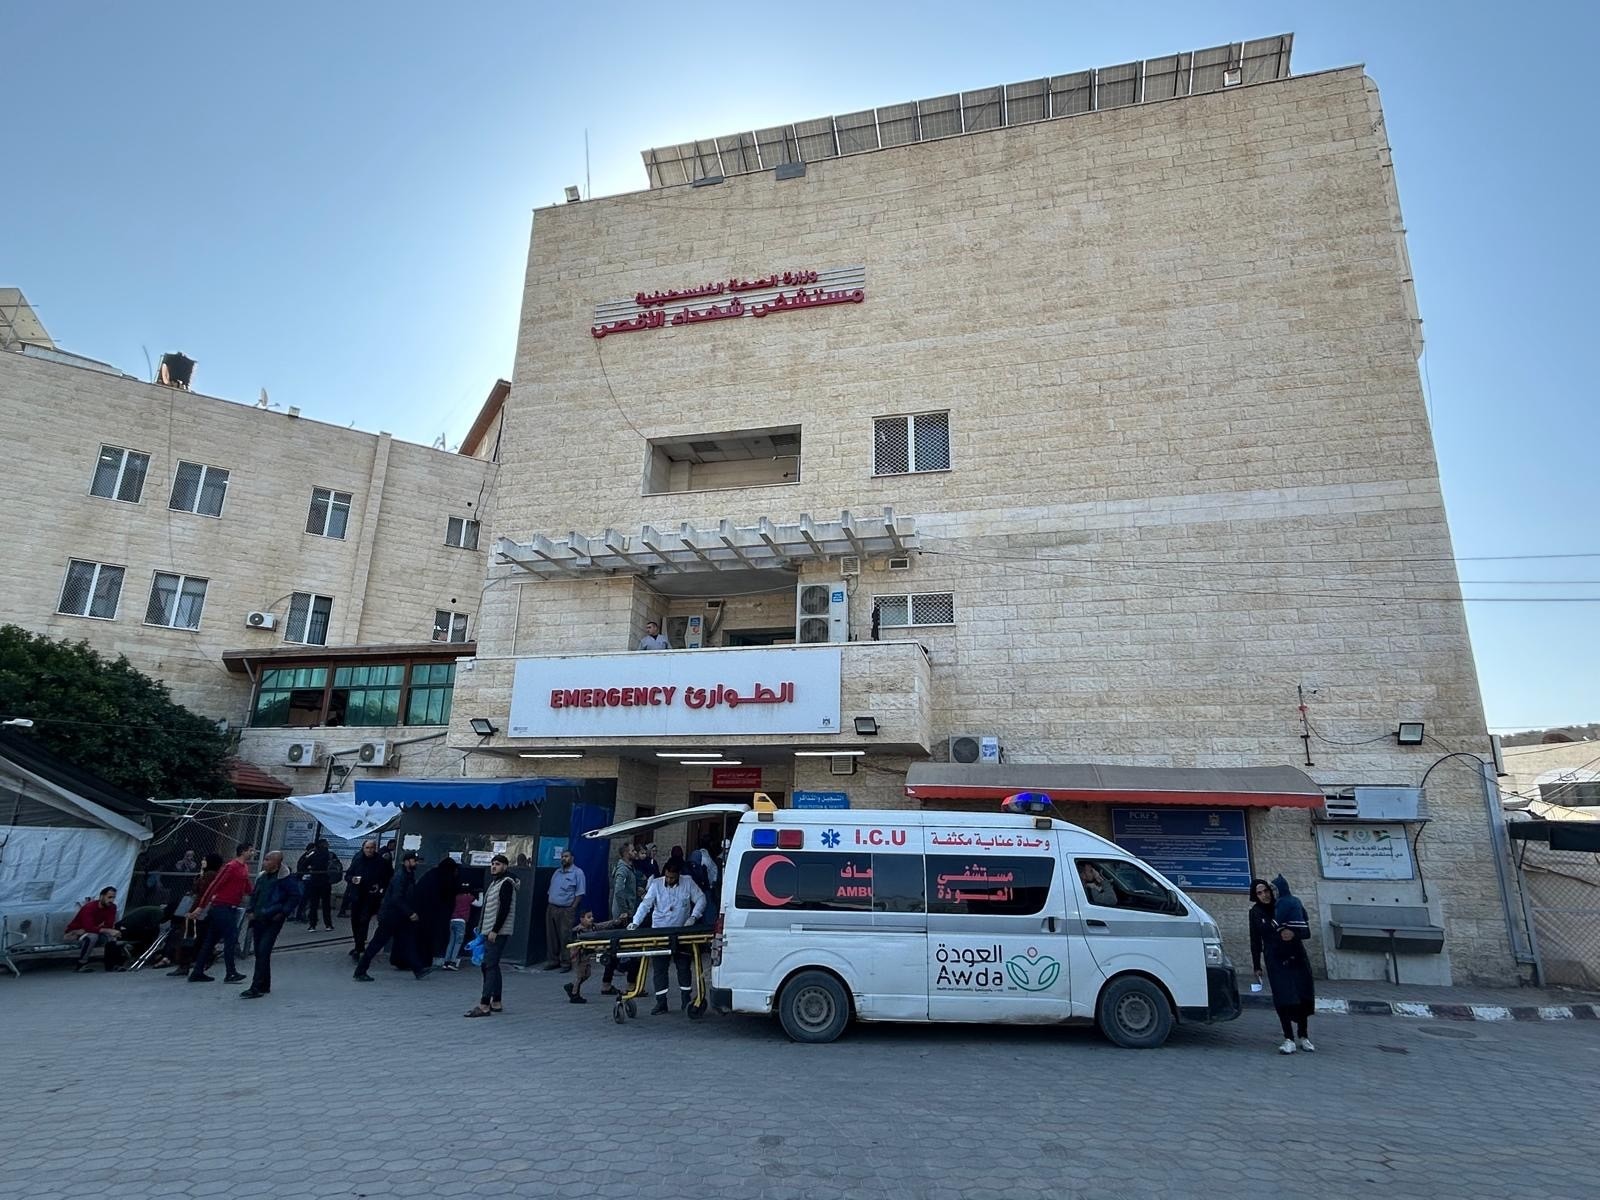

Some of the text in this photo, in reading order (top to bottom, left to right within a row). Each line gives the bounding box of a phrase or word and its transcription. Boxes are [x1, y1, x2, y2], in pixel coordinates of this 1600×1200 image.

[728, 274, 778, 292] الصحة
[783, 270, 818, 286] وزارة
[671, 296, 745, 326] شهداء
[550, 685, 677, 708] EMERGENCY
[684, 682, 794, 709] الطوارئ
[855, 829, 906, 846] I.C.U
[931, 832, 1050, 851] وحدة عناية مكثفة
[937, 885, 1013, 903] العودة
[936, 943, 1003, 967] العودة
[936, 965, 1003, 986] Awda
